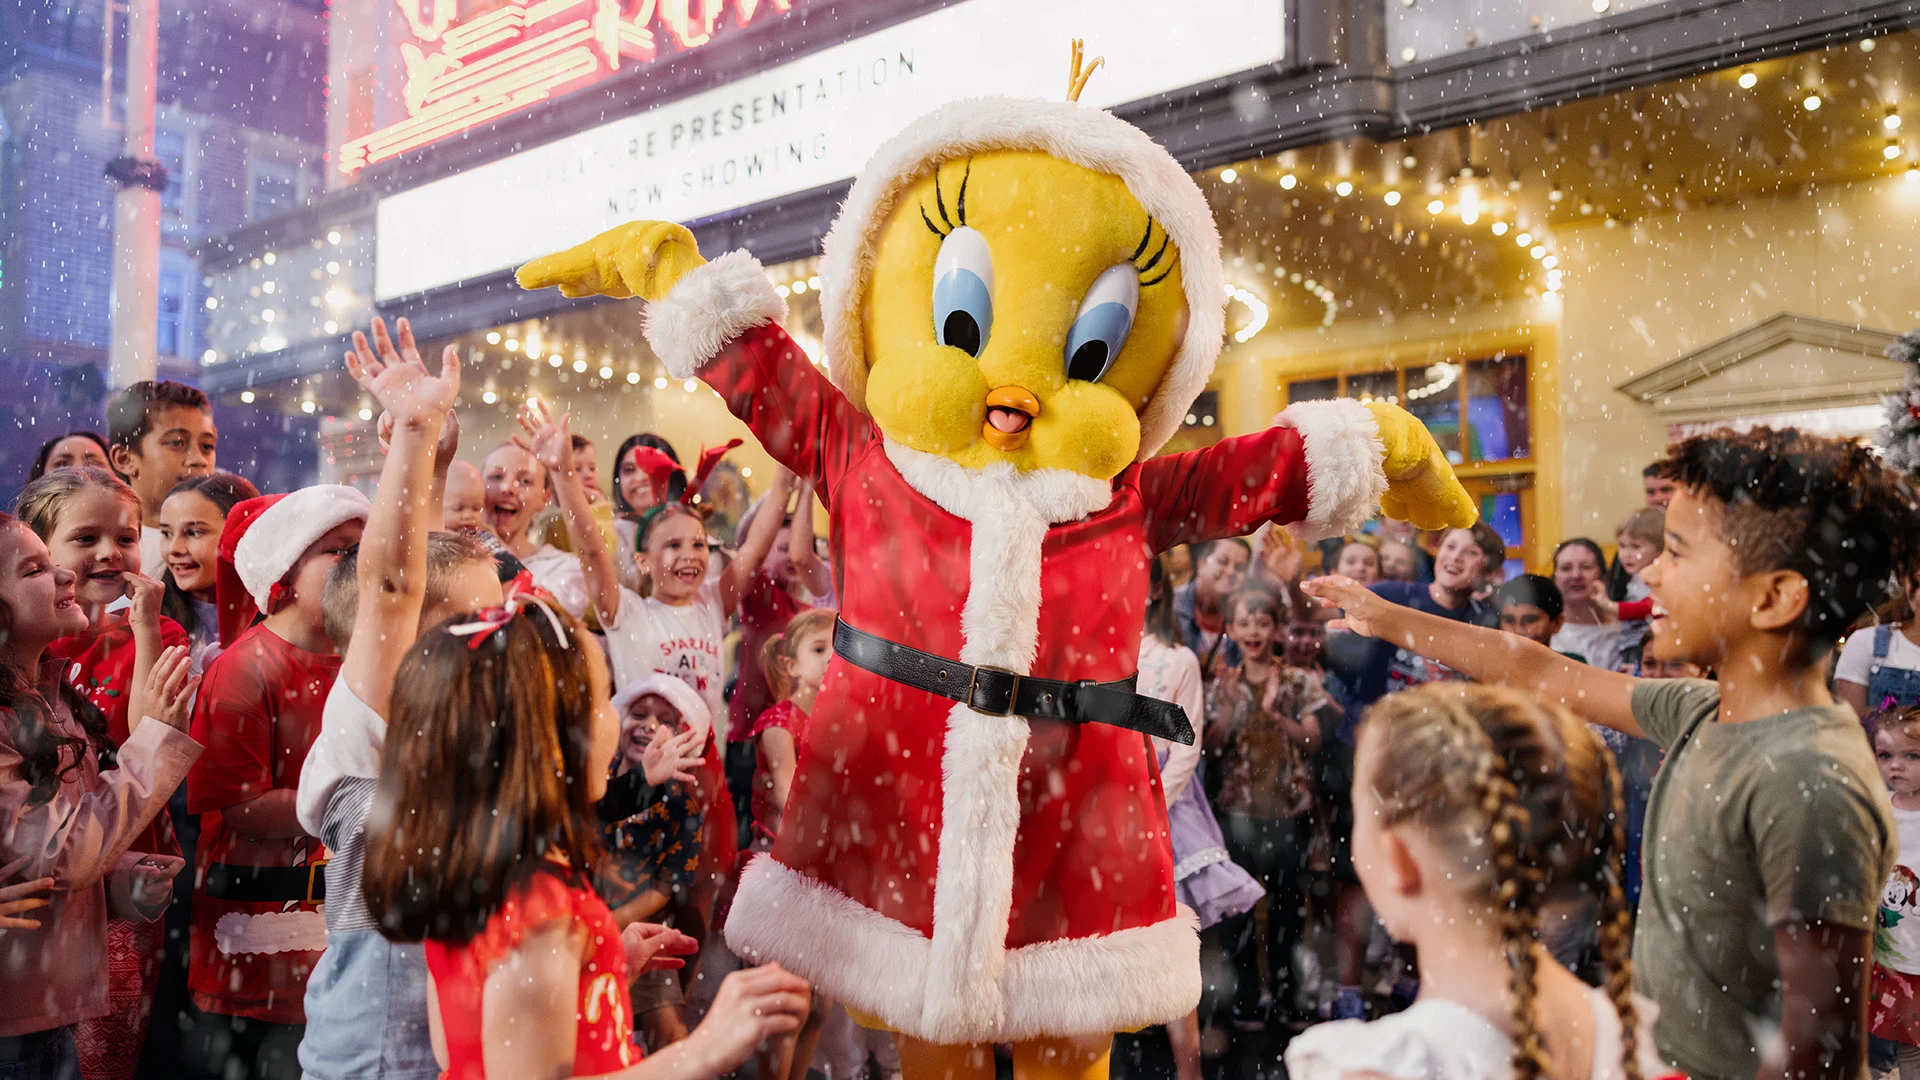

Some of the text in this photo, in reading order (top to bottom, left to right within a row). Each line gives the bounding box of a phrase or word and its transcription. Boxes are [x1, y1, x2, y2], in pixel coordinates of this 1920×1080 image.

[543, 47, 915, 183] FEARE PRESENTATION
[607, 133, 829, 216] NOW SHOWING
